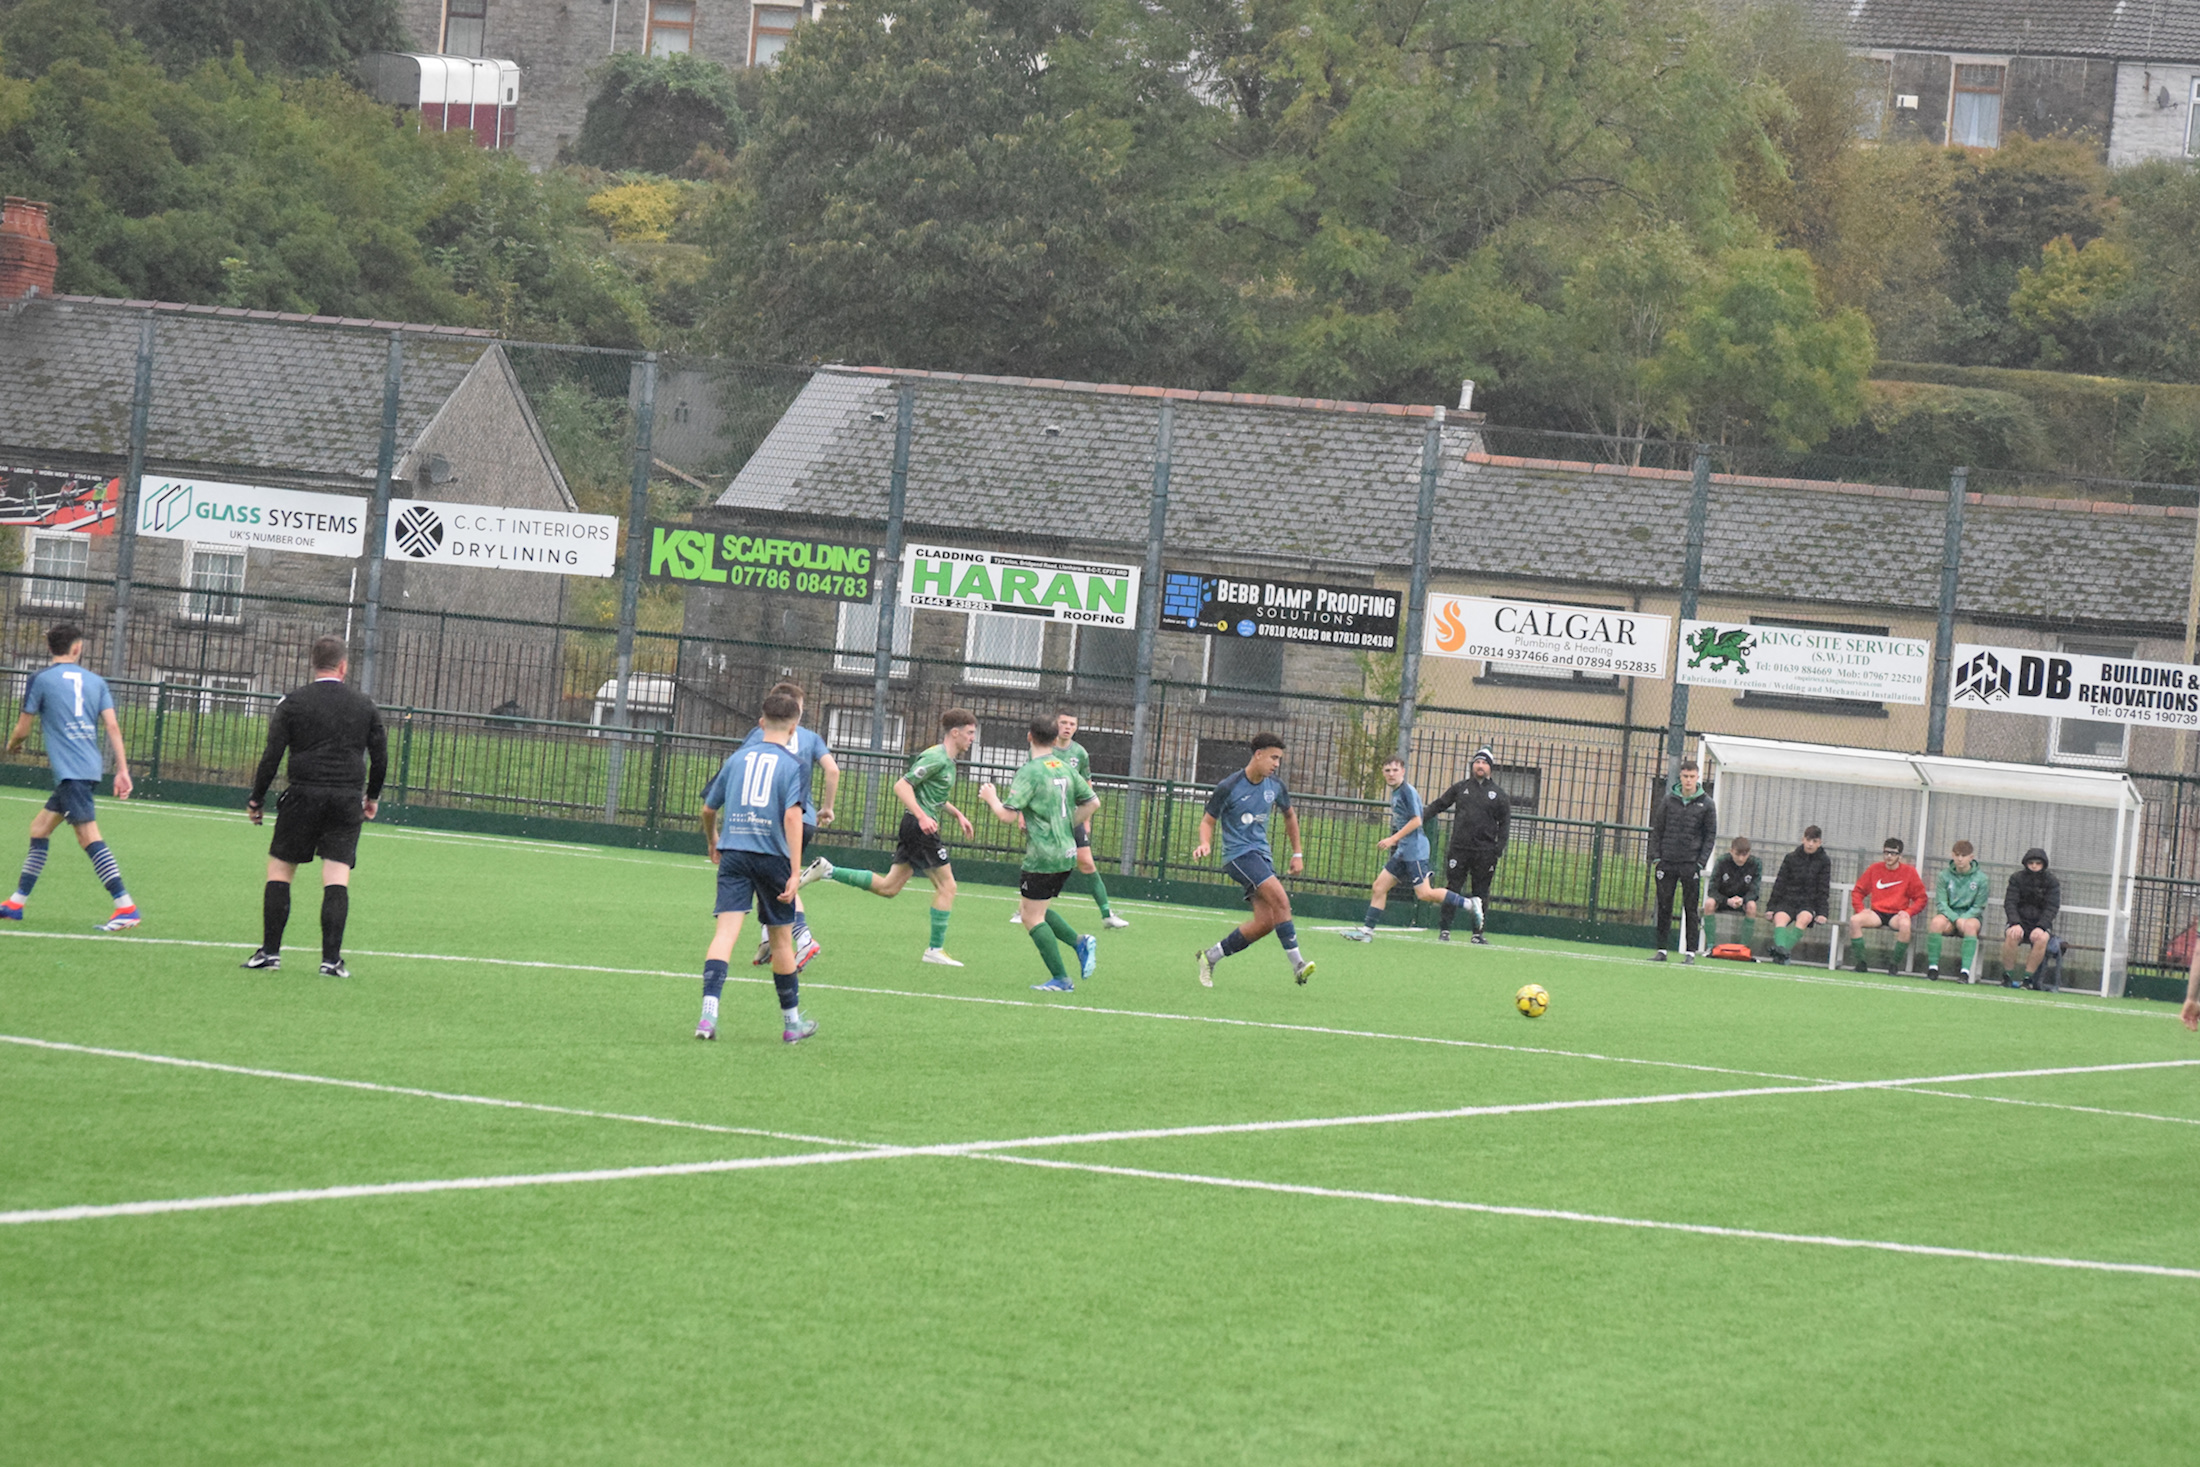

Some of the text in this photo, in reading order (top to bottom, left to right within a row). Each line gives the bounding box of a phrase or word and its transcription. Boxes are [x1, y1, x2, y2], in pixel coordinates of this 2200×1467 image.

[196, 502, 358, 534] GLASS SYSTEMS
[512, 520, 609, 540] INTERIORS
[230, 530, 315, 547] UK'S NUMBER ONE
[452, 542, 578, 564] DRYLINING
[650, 527, 728, 582] KSL
[722, 534, 870, 574] SCAFFOLDING
[916, 548, 984, 562] CLADDING
[731, 565, 868, 598] 07786 084783
[912, 559, 1128, 614] HARAN
[913, 596, 993, 611] 01443 238283
[1264, 584, 1312, 610] DAMP
[1316, 588, 1396, 618] PROOFING
[1064, 611, 1124, 624] ROOFING
[1256, 606, 1354, 626] SOLUTIONS
[1494, 606, 1636, 646] CALGAR
[1258, 624, 1285, 638] 07810
[1320, 631, 1331, 642] OR
[1333, 631, 1360, 645] 07810
[1514, 636, 1613, 656] Plumbing & Heating
[1761, 632, 1924, 657] KING SITE SERVICES
[1469, 644, 1656, 673] 07814 937466 and 07894 952835
[1812, 652, 1870, 666] (S.W.) LTD
[1756, 662, 1770, 671] Tel:
[1774, 664, 1799, 674] 01639
[1838, 668, 1860, 679] Mob:
[1863, 671, 1888, 681] 07967
[1891, 674, 1922, 684] 225210
[2018, 656, 2072, 700] DB
[2101, 664, 2200, 690] BUILDING &
[1682, 674, 1726, 684] Fabrication
[1734, 679, 1766, 688] Erection
[1774, 682, 1806, 692] Welding
[1808, 685, 1822, 693] and
[1825, 686, 1870, 698] Mechanical
[1872, 690, 1921, 702] Installations
[2078, 684, 2198, 712] RENOVATIONS
[2090, 705, 2198, 724] Tel: 07415 190739
[741, 752, 779, 808] 10
[1052, 778, 1068, 818] 7
